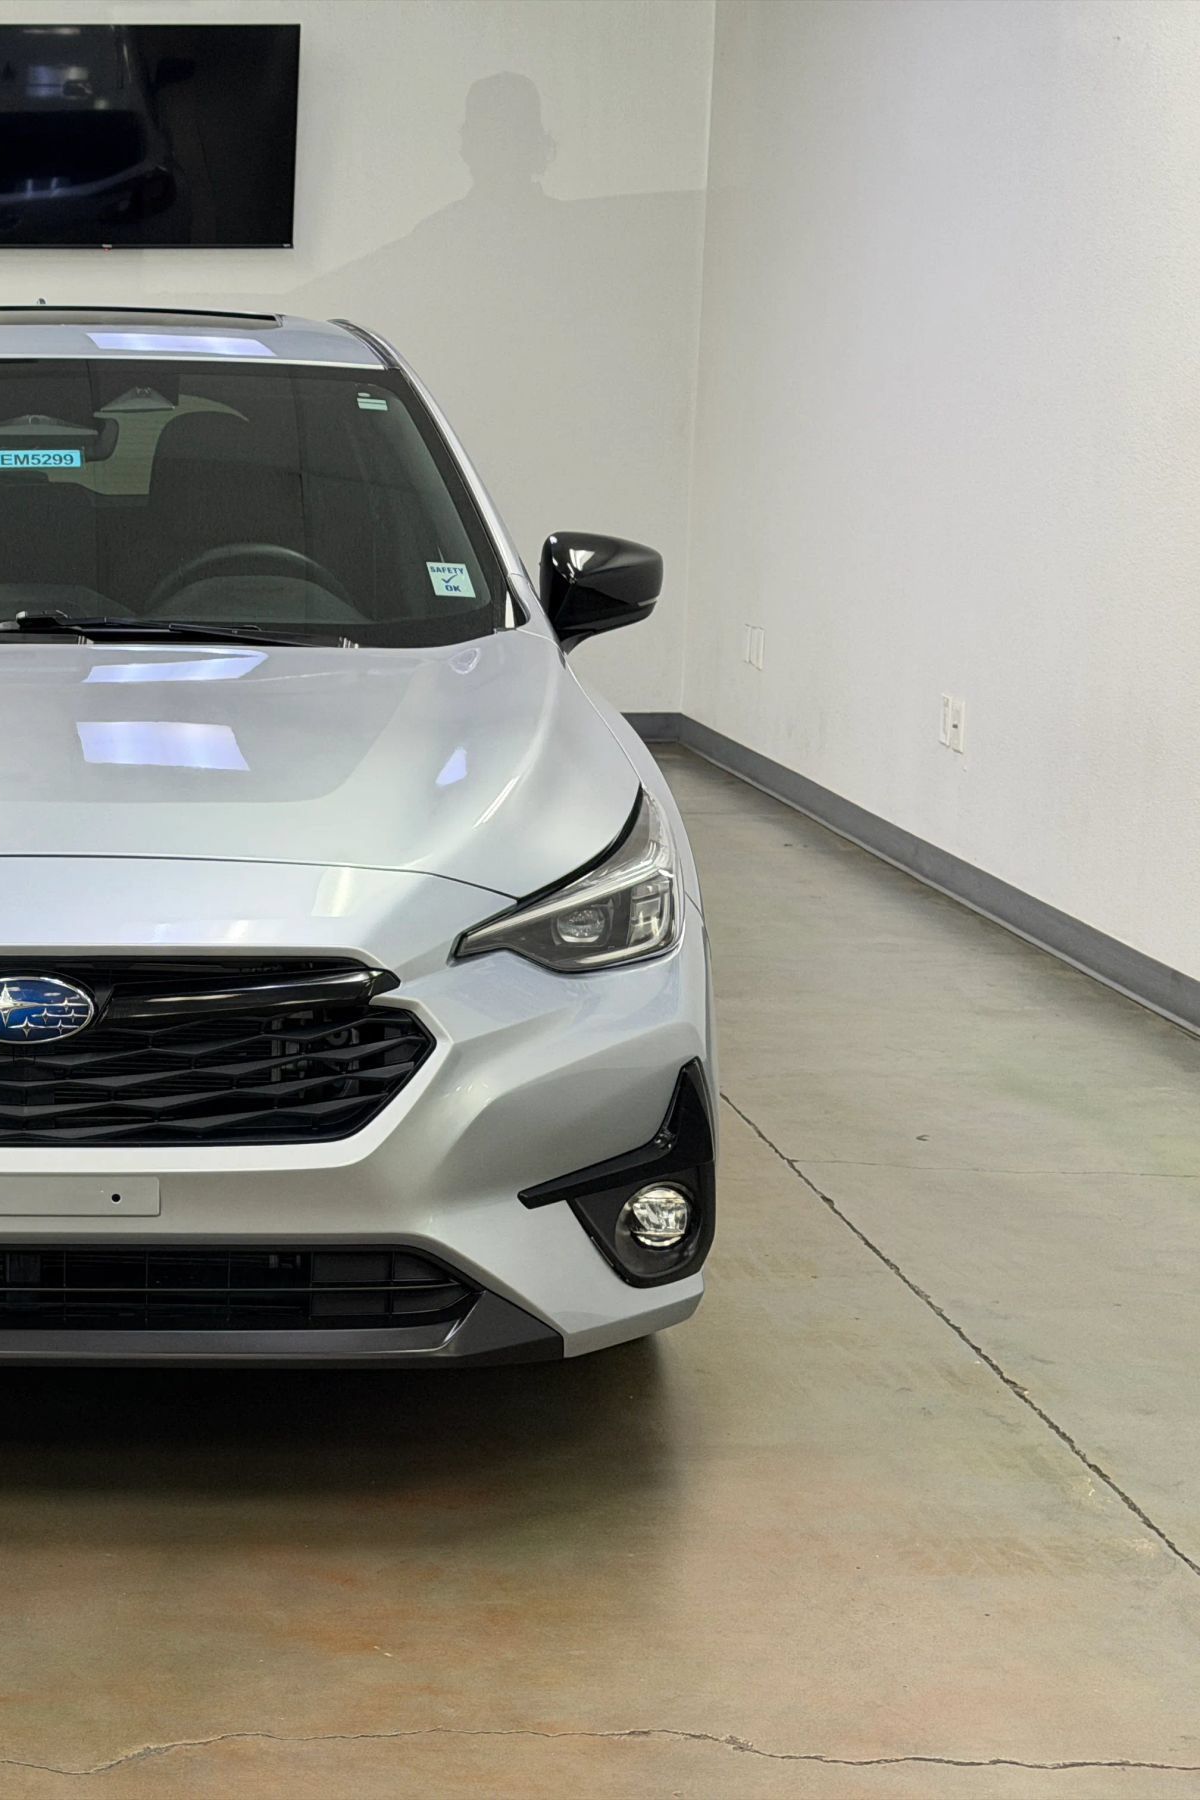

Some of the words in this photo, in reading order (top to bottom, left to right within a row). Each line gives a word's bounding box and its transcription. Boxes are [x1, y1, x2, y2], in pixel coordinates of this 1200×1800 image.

[0, 453, 74, 466] EM5299
[430, 566, 464, 575] SAFETY
[445, 584, 462, 592] OK
